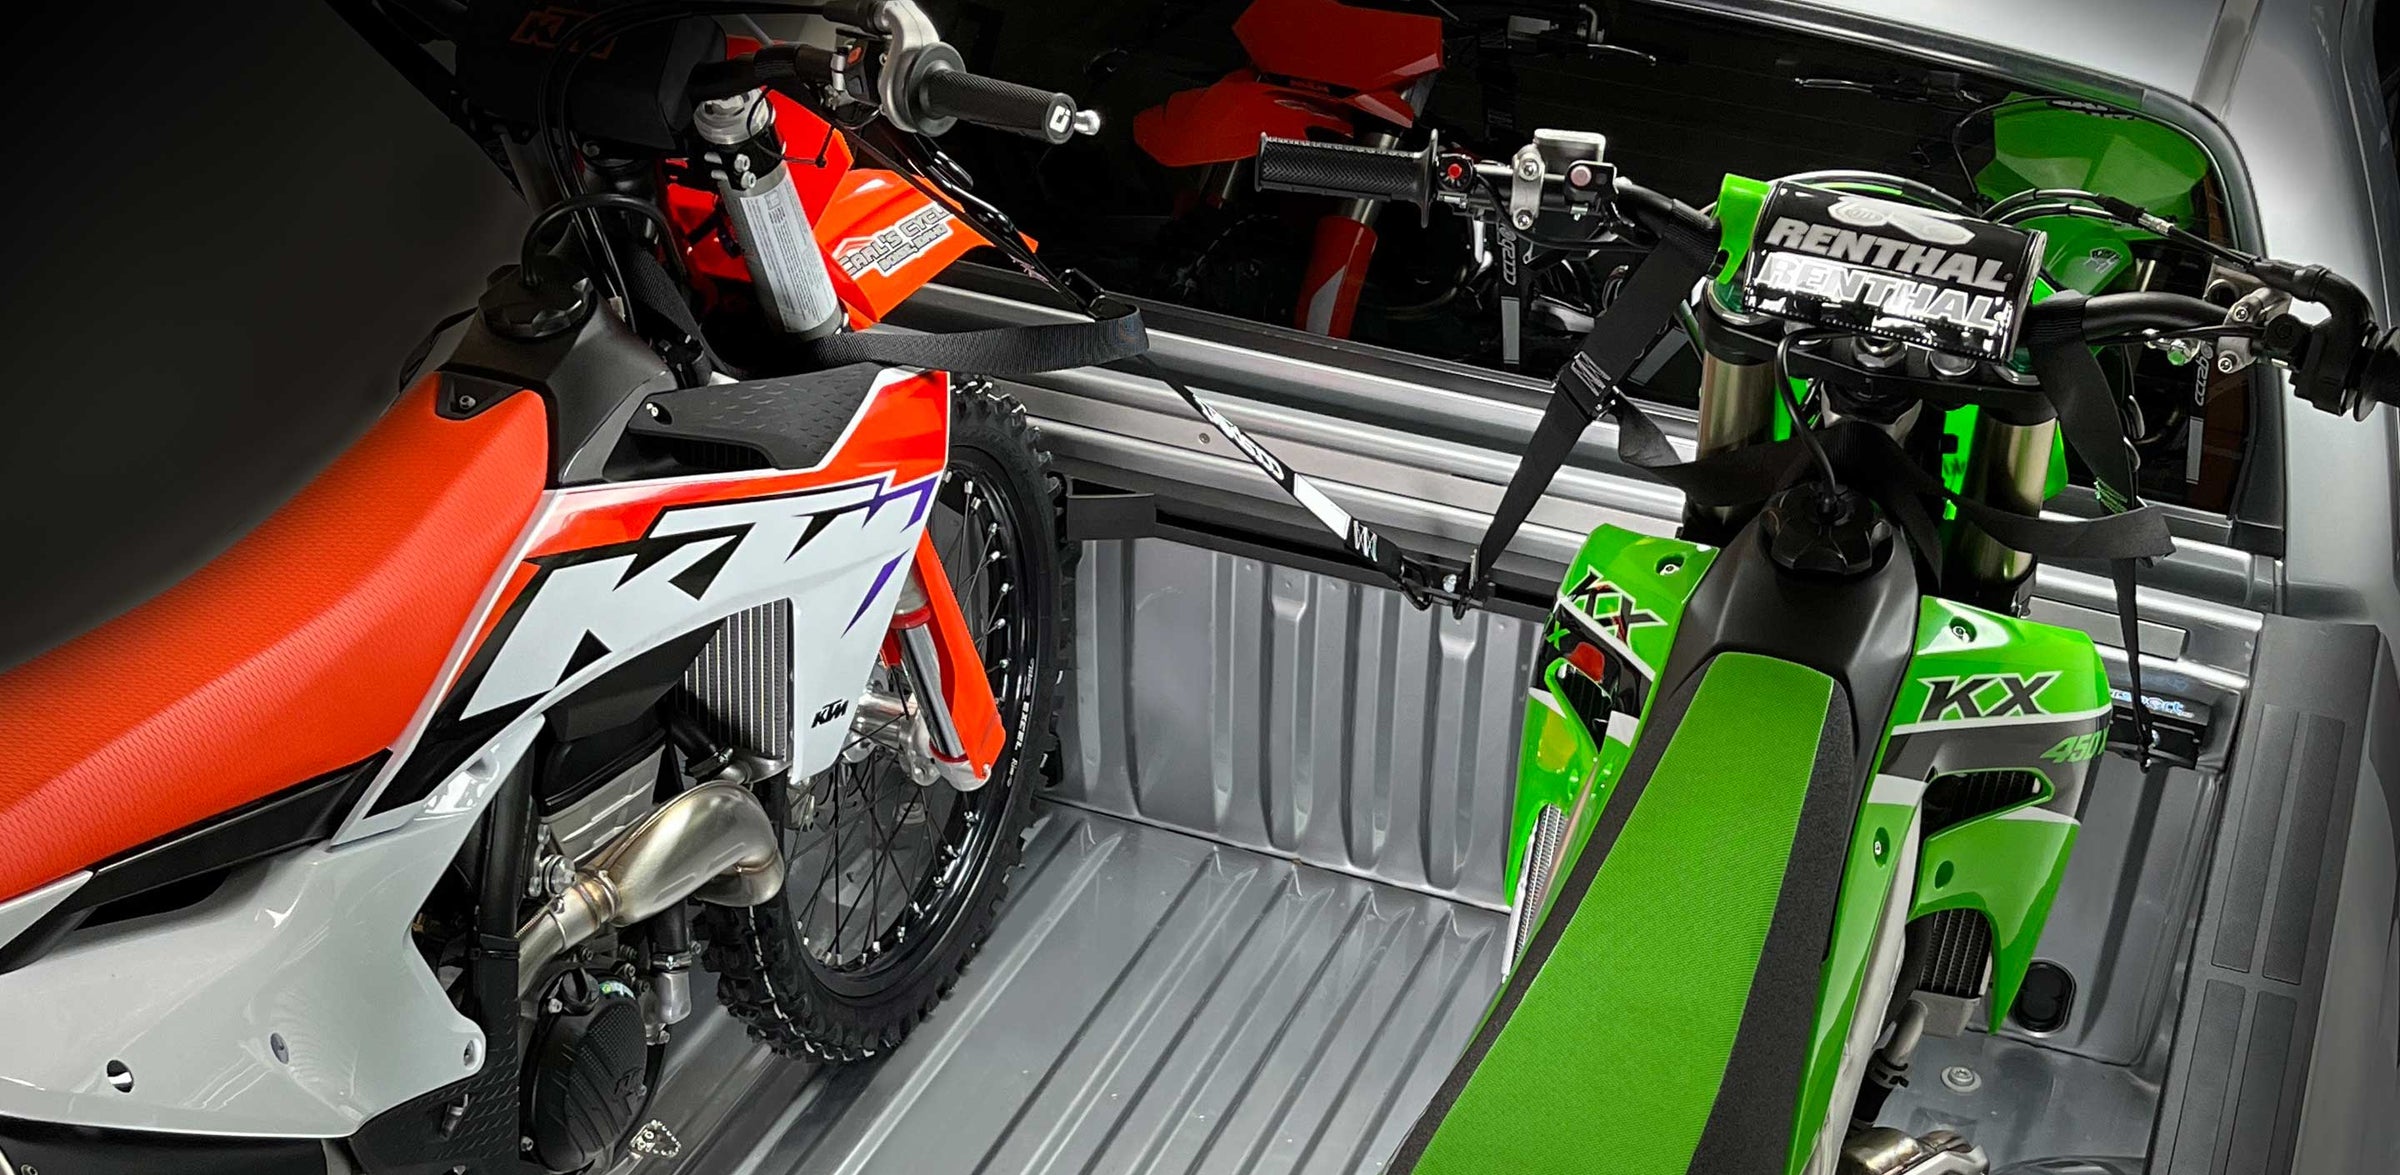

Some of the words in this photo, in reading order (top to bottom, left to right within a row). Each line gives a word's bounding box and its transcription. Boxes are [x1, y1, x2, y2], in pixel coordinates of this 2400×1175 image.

[899, 206, 952, 238] CYCL
[1764, 216, 2009, 292] RENTHAL
[1755, 251, 1998, 334] RENTHAL
[460, 477, 934, 721] KTM
[1563, 565, 1668, 650] KX
[811, 698, 848, 728] KTM
[1015, 702, 1030, 750] EXCEL
[1918, 671, 2063, 723] KX
